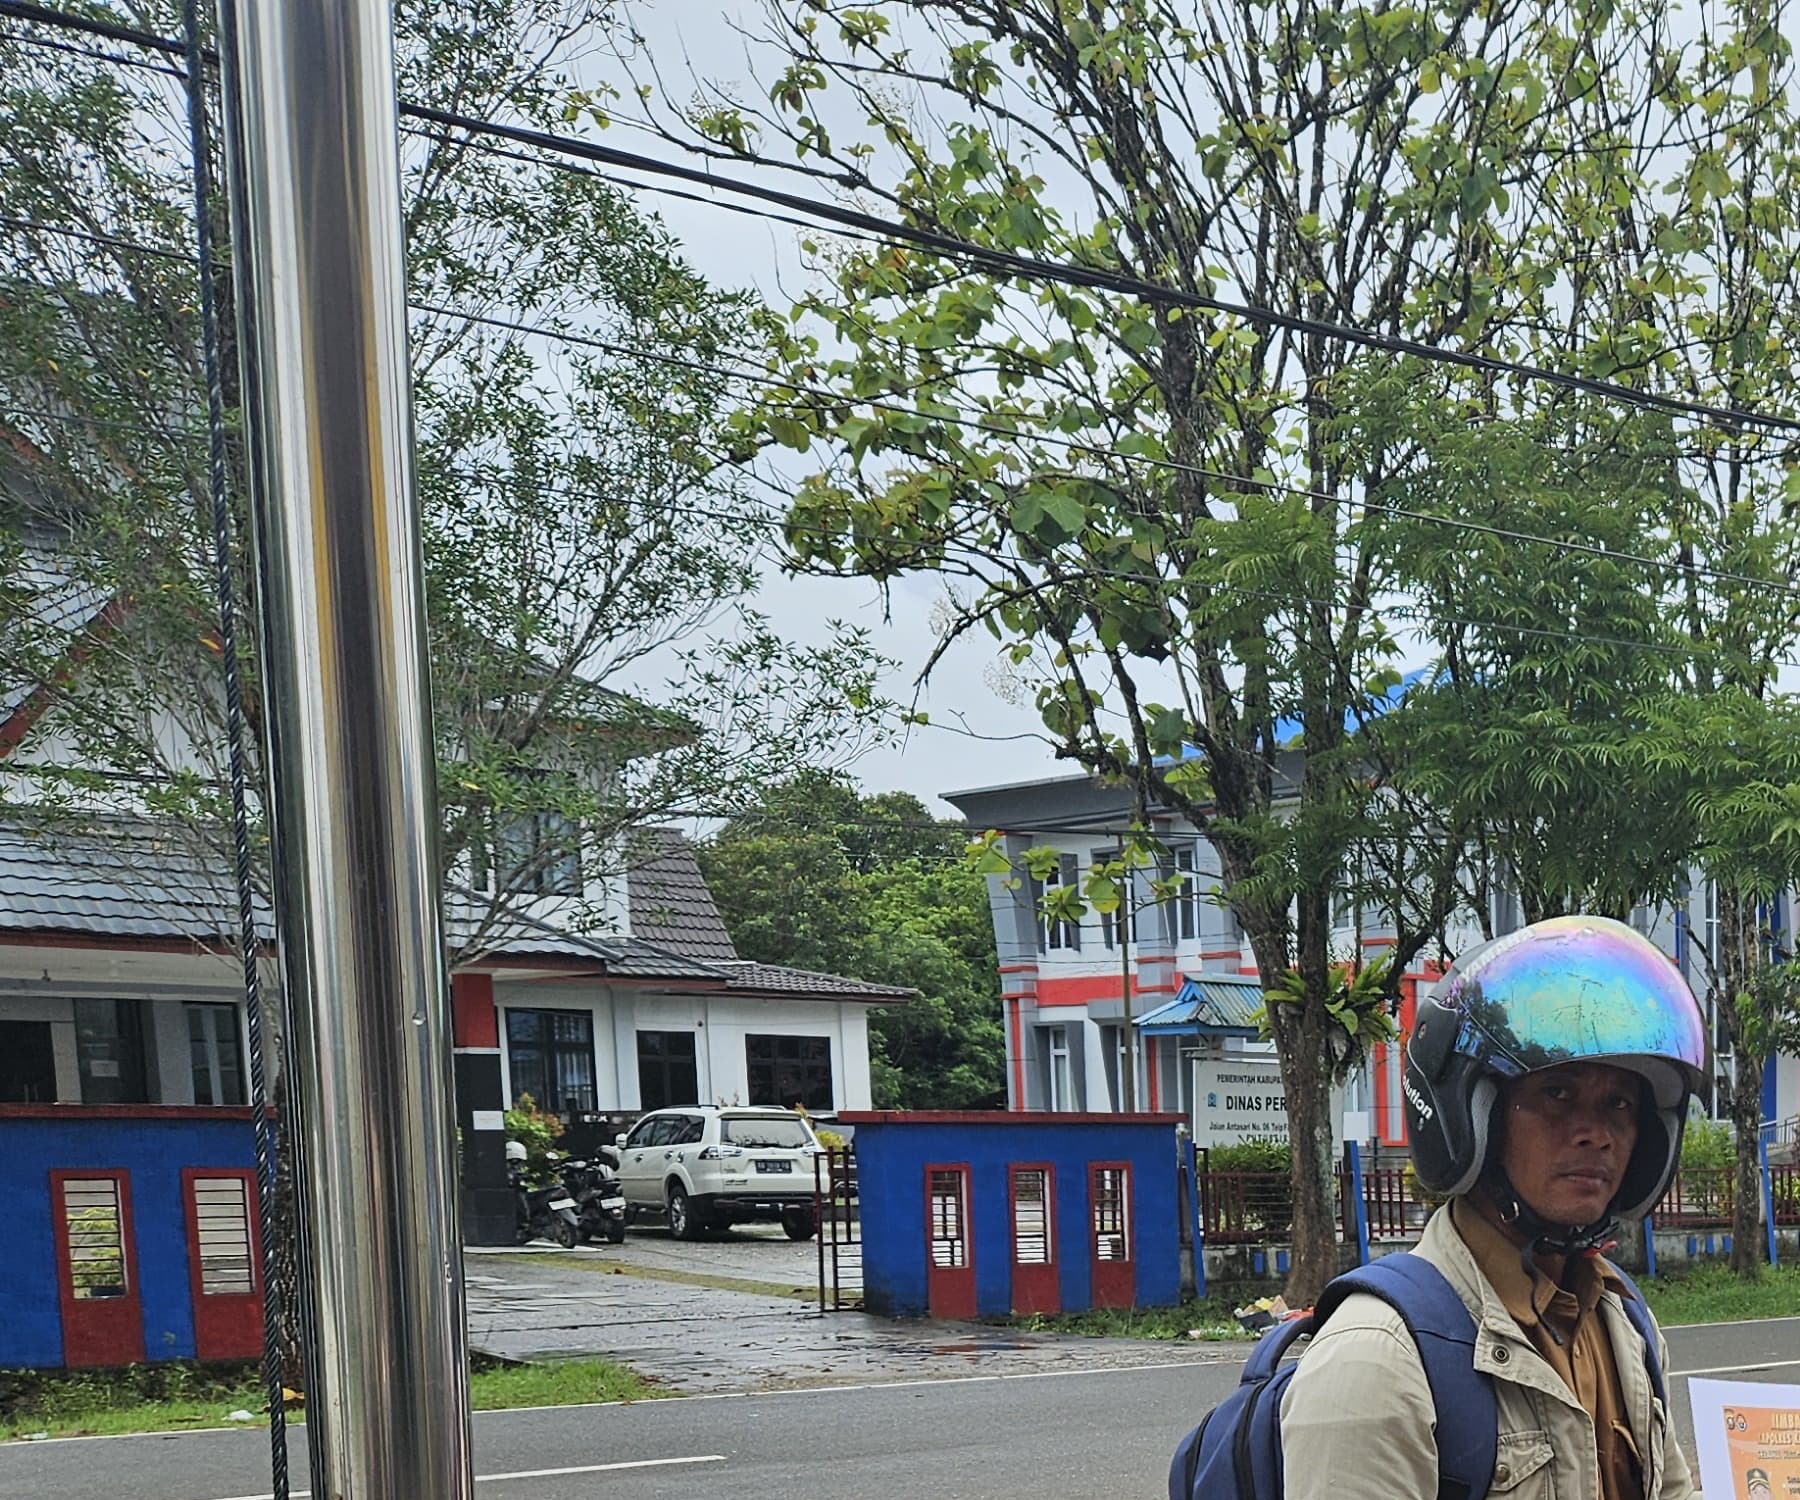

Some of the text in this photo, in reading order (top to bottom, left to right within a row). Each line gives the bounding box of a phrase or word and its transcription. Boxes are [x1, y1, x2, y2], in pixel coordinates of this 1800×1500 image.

[1217, 1074, 1255, 1084] PEMERINTAH
[1226, 1095, 1287, 1111] DINAS PER
